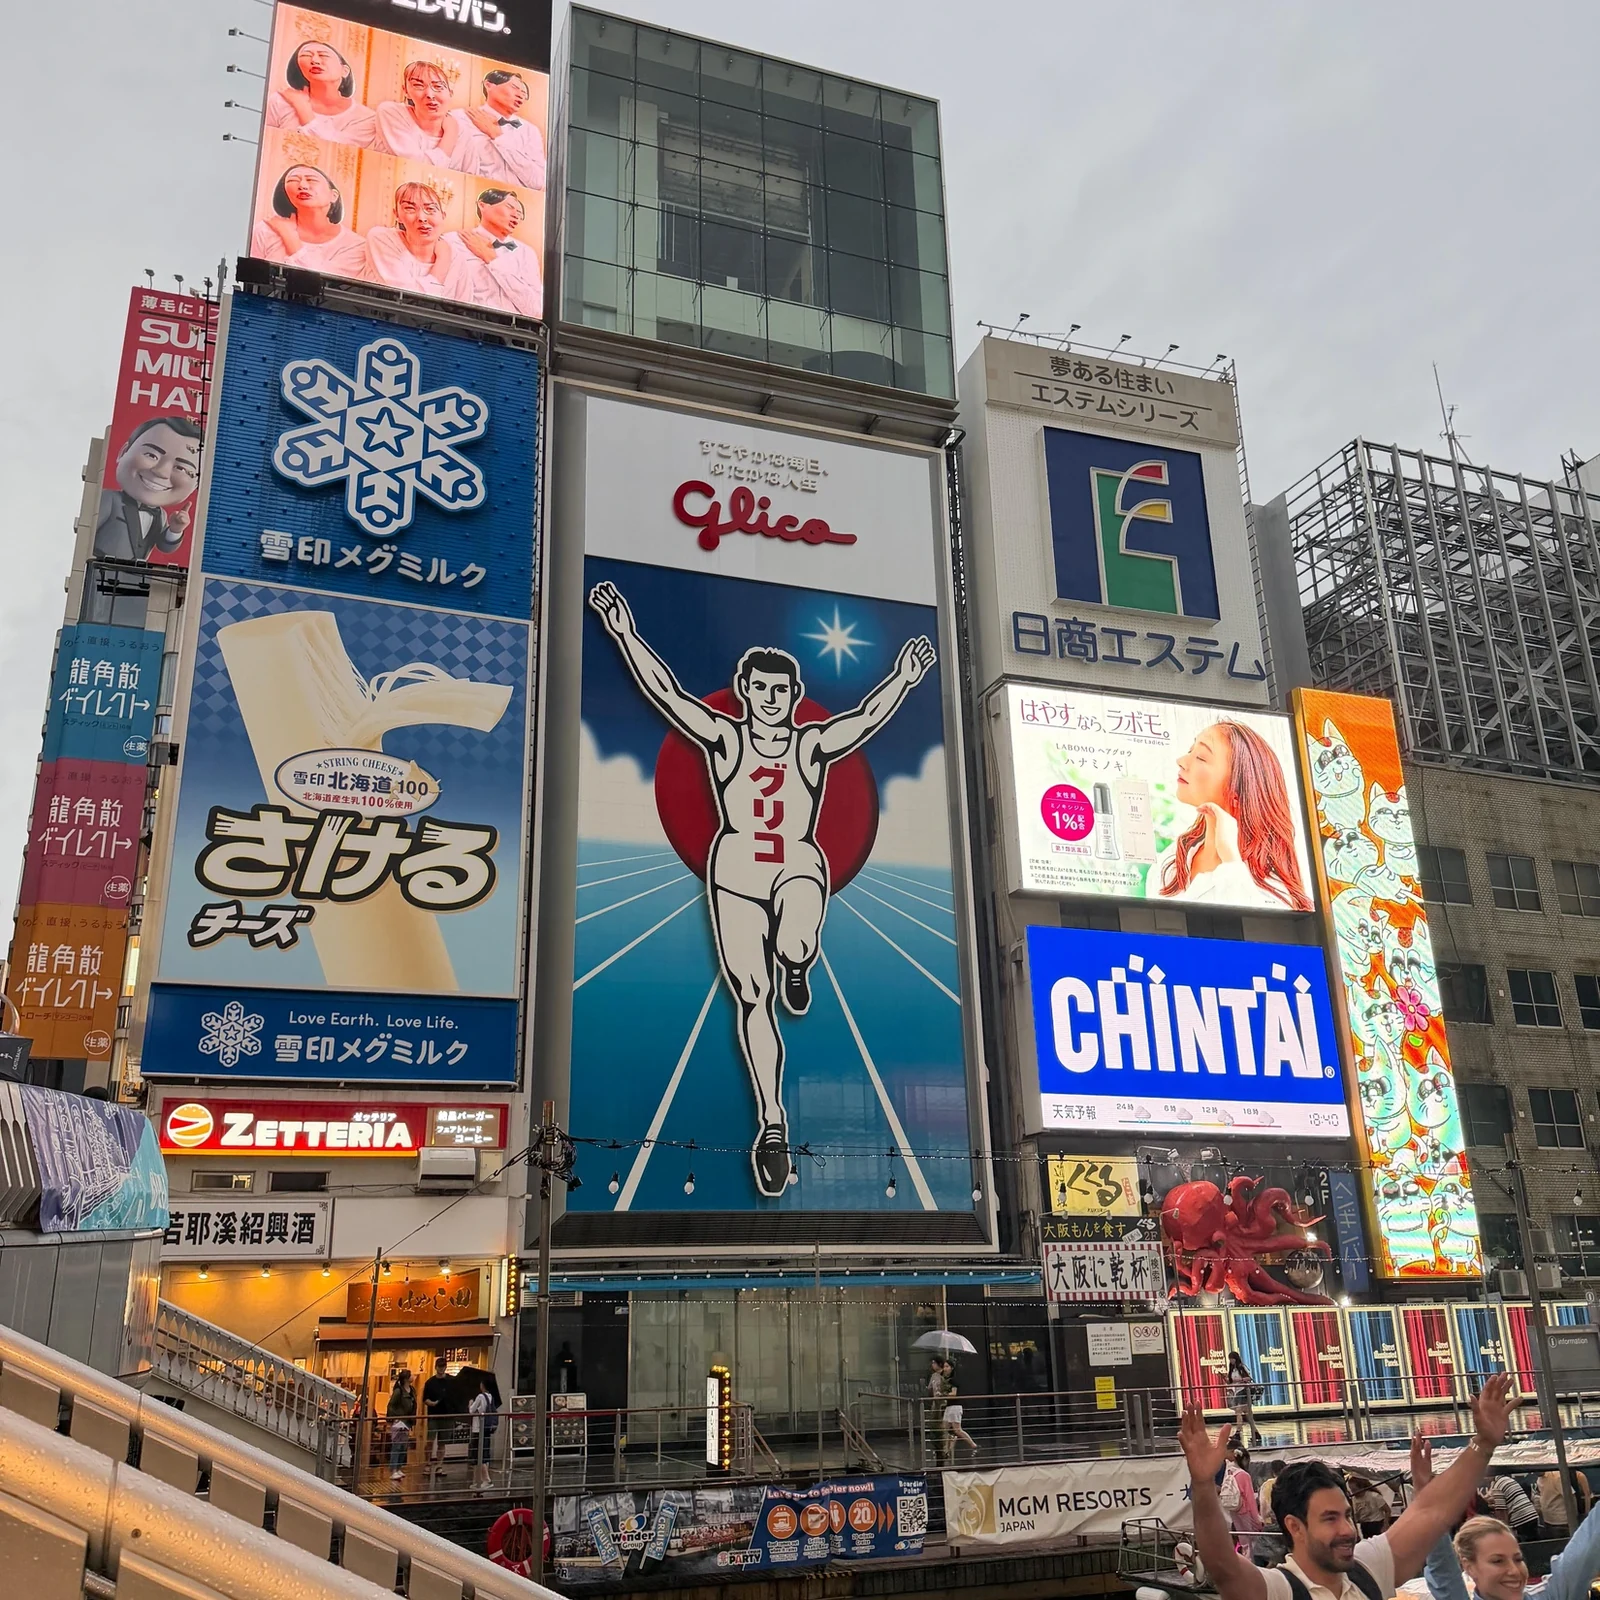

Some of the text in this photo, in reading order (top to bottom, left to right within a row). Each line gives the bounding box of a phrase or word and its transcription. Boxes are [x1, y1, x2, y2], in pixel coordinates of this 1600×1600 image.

[1050, 356, 1174, 395] 夢ある住まい
[1031, 383, 1199, 431] エステムシリーズ
[260, 529, 487, 588] 雪印メグミルク
[1012, 611, 1266, 681] 日商エステム
[69, 657, 141, 690] 龍角散
[59, 687, 151, 719] ダイレクト
[125, 741, 147, 752] 生薬
[1056, 743, 1095, 753] LABOMO
[323, 757, 398, 775] STRING CHEESE
[1065, 757, 1123, 771] ハナミノキ
[302, 792, 413, 810] 北海道産生乳100%使用
[1056, 791, 1077, 799] 女性用
[48, 795, 124, 827] 龍角散
[749, 763, 787, 864] グリコ
[1050, 803, 1084, 811] ミノキシジル
[1052, 810, 1078, 830] 1%
[37, 827, 133, 859] ダイレクト
[196, 804, 500, 912] さける
[107, 883, 129, 892] 生薬
[187, 900, 316, 949] チーズ
[26, 942, 104, 976] 龍角散
[15, 977, 114, 1009] ダイレクト
[289, 1010, 459, 1031] Love Earth. Love Life.
[86, 1037, 109, 1048] 生薬
[275, 1033, 469, 1065] 雪印メグミルク
[353, 1112, 397, 1122] ゼッテリア
[1052, 1104, 1097, 1120] 天気予報
[1116, 1103, 1134, 1111] 24時
[1202, 1106, 1218, 1114] 12時
[1309, 1113, 1339, 1126] 18:40
[221, 1112, 412, 1148] ZETTERIA
[435, 1125, 482, 1134] フェアトレード
[455, 1134, 493, 1143] コーヒー
[1067, 1163, 1123, 1207] くくる
[1043, 1222, 1126, 1239] 大阪もんを食す
[1144, 1232, 1158, 1241] 2F
[1052, 1252, 1149, 1291] 大阪に乾杯
[1558, 1337, 1588, 1345] information
[999, 1493, 1050, 1518] MGM
[1056, 1487, 1152, 1513] RESORTS
[611, 1531, 654, 1543] Wonder
[656, 1517, 666, 1552] CRUISE
[1001, 1520, 1035, 1533] JAPAN
[593, 1524, 615, 1554] CRUISE
[729, 1554, 761, 1564] PARTY
